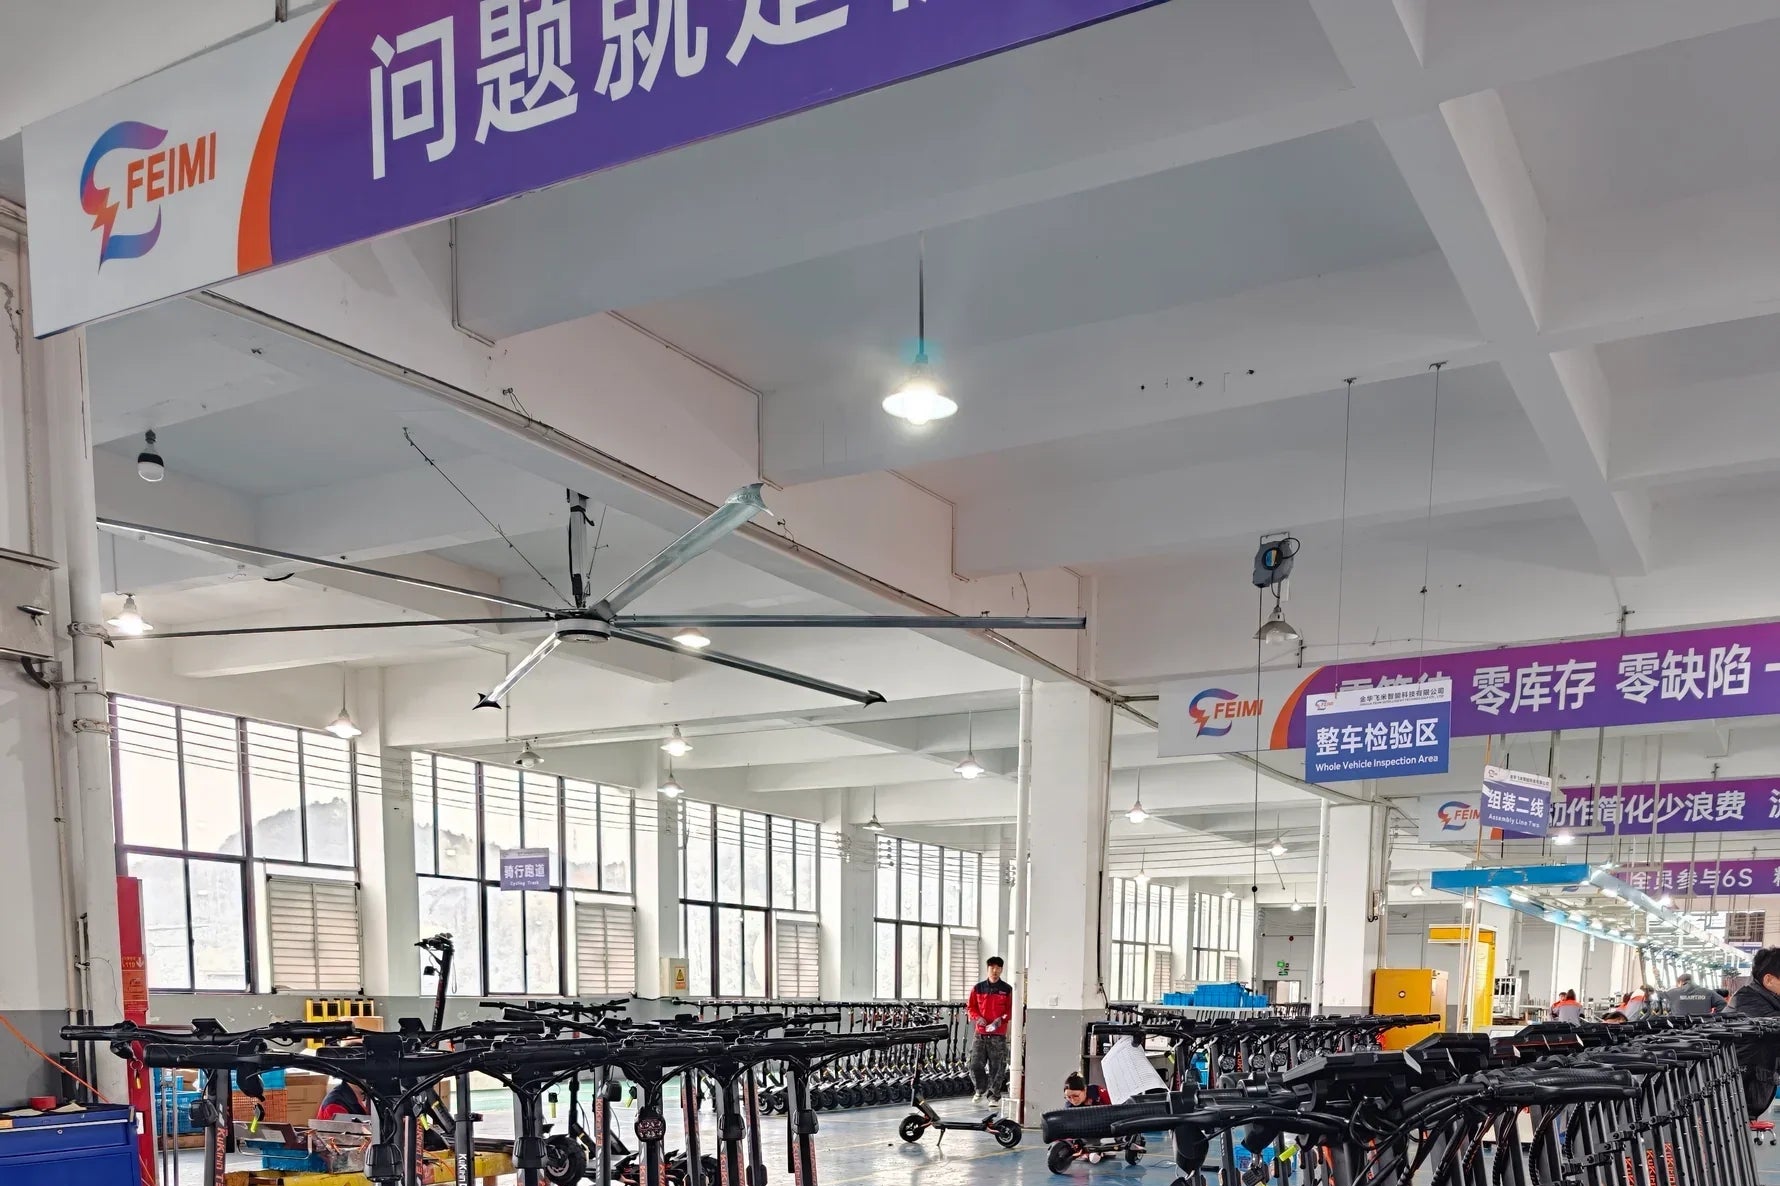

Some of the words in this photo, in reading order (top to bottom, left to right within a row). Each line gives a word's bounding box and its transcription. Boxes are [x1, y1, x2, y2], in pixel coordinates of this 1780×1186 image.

[126, 131, 218, 210] FEIMI
[1470, 659, 1597, 716] 零库存
[1616, 643, 1751, 705] 零缺陷
[1214, 699, 1264, 719] FEIMI
[1316, 718, 1439, 756] 整车检验区
[1315, 761, 1341, 772] Whole
[1343, 758, 1372, 770] Vehicle
[1374, 756, 1417, 769] Inspection
[1418, 754, 1439, 764] Area
[1454, 809, 1480, 821] FEIM
[1487, 789, 1544, 818] 组装二线
[1488, 813, 1515, 825] Assembly
[1515, 818, 1528, 826] Line
[1528, 820, 1540, 828] Two
